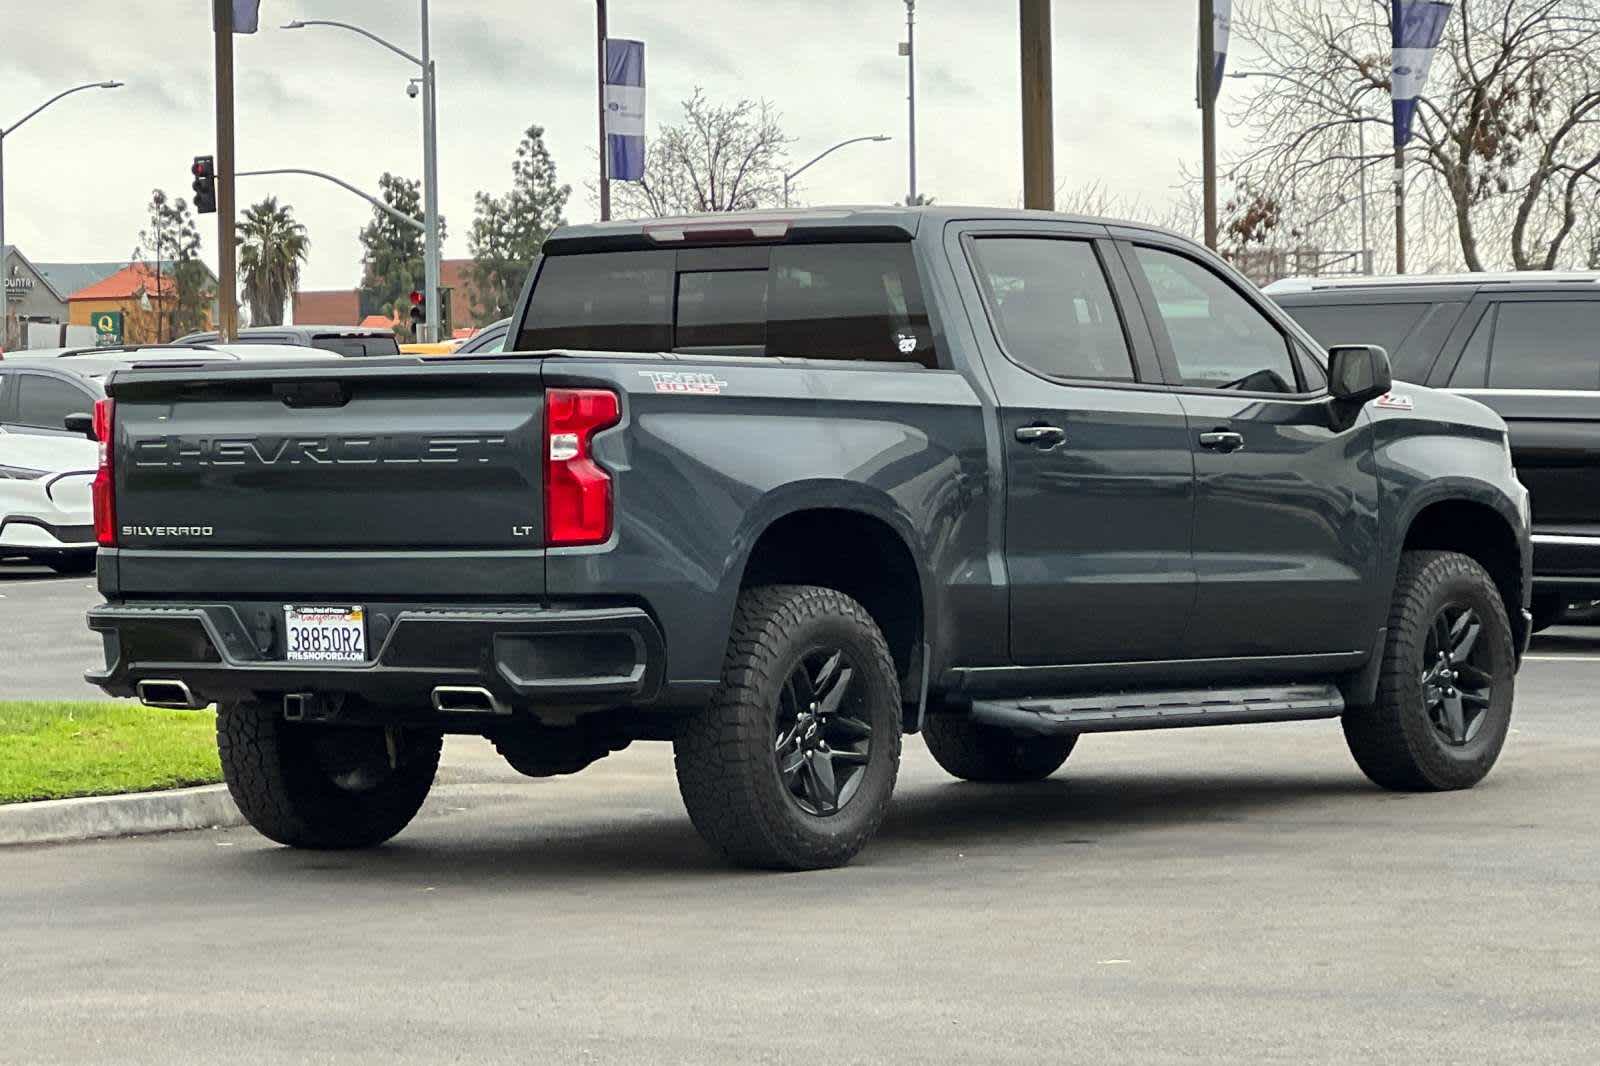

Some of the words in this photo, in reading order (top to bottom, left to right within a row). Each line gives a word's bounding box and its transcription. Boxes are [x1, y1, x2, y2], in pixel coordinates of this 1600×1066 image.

[4, 278, 36, 288] OUNTRY
[98, 315, 113, 332] Q
[655, 383, 721, 395] BOSS
[136, 435, 505, 466] CHEVROLET
[122, 525, 214, 536] SILVERADO
[512, 526, 533, 536] LT
[290, 627, 362, 651] 38850R2
[287, 651, 364, 661] FRESNOFORD.COM
